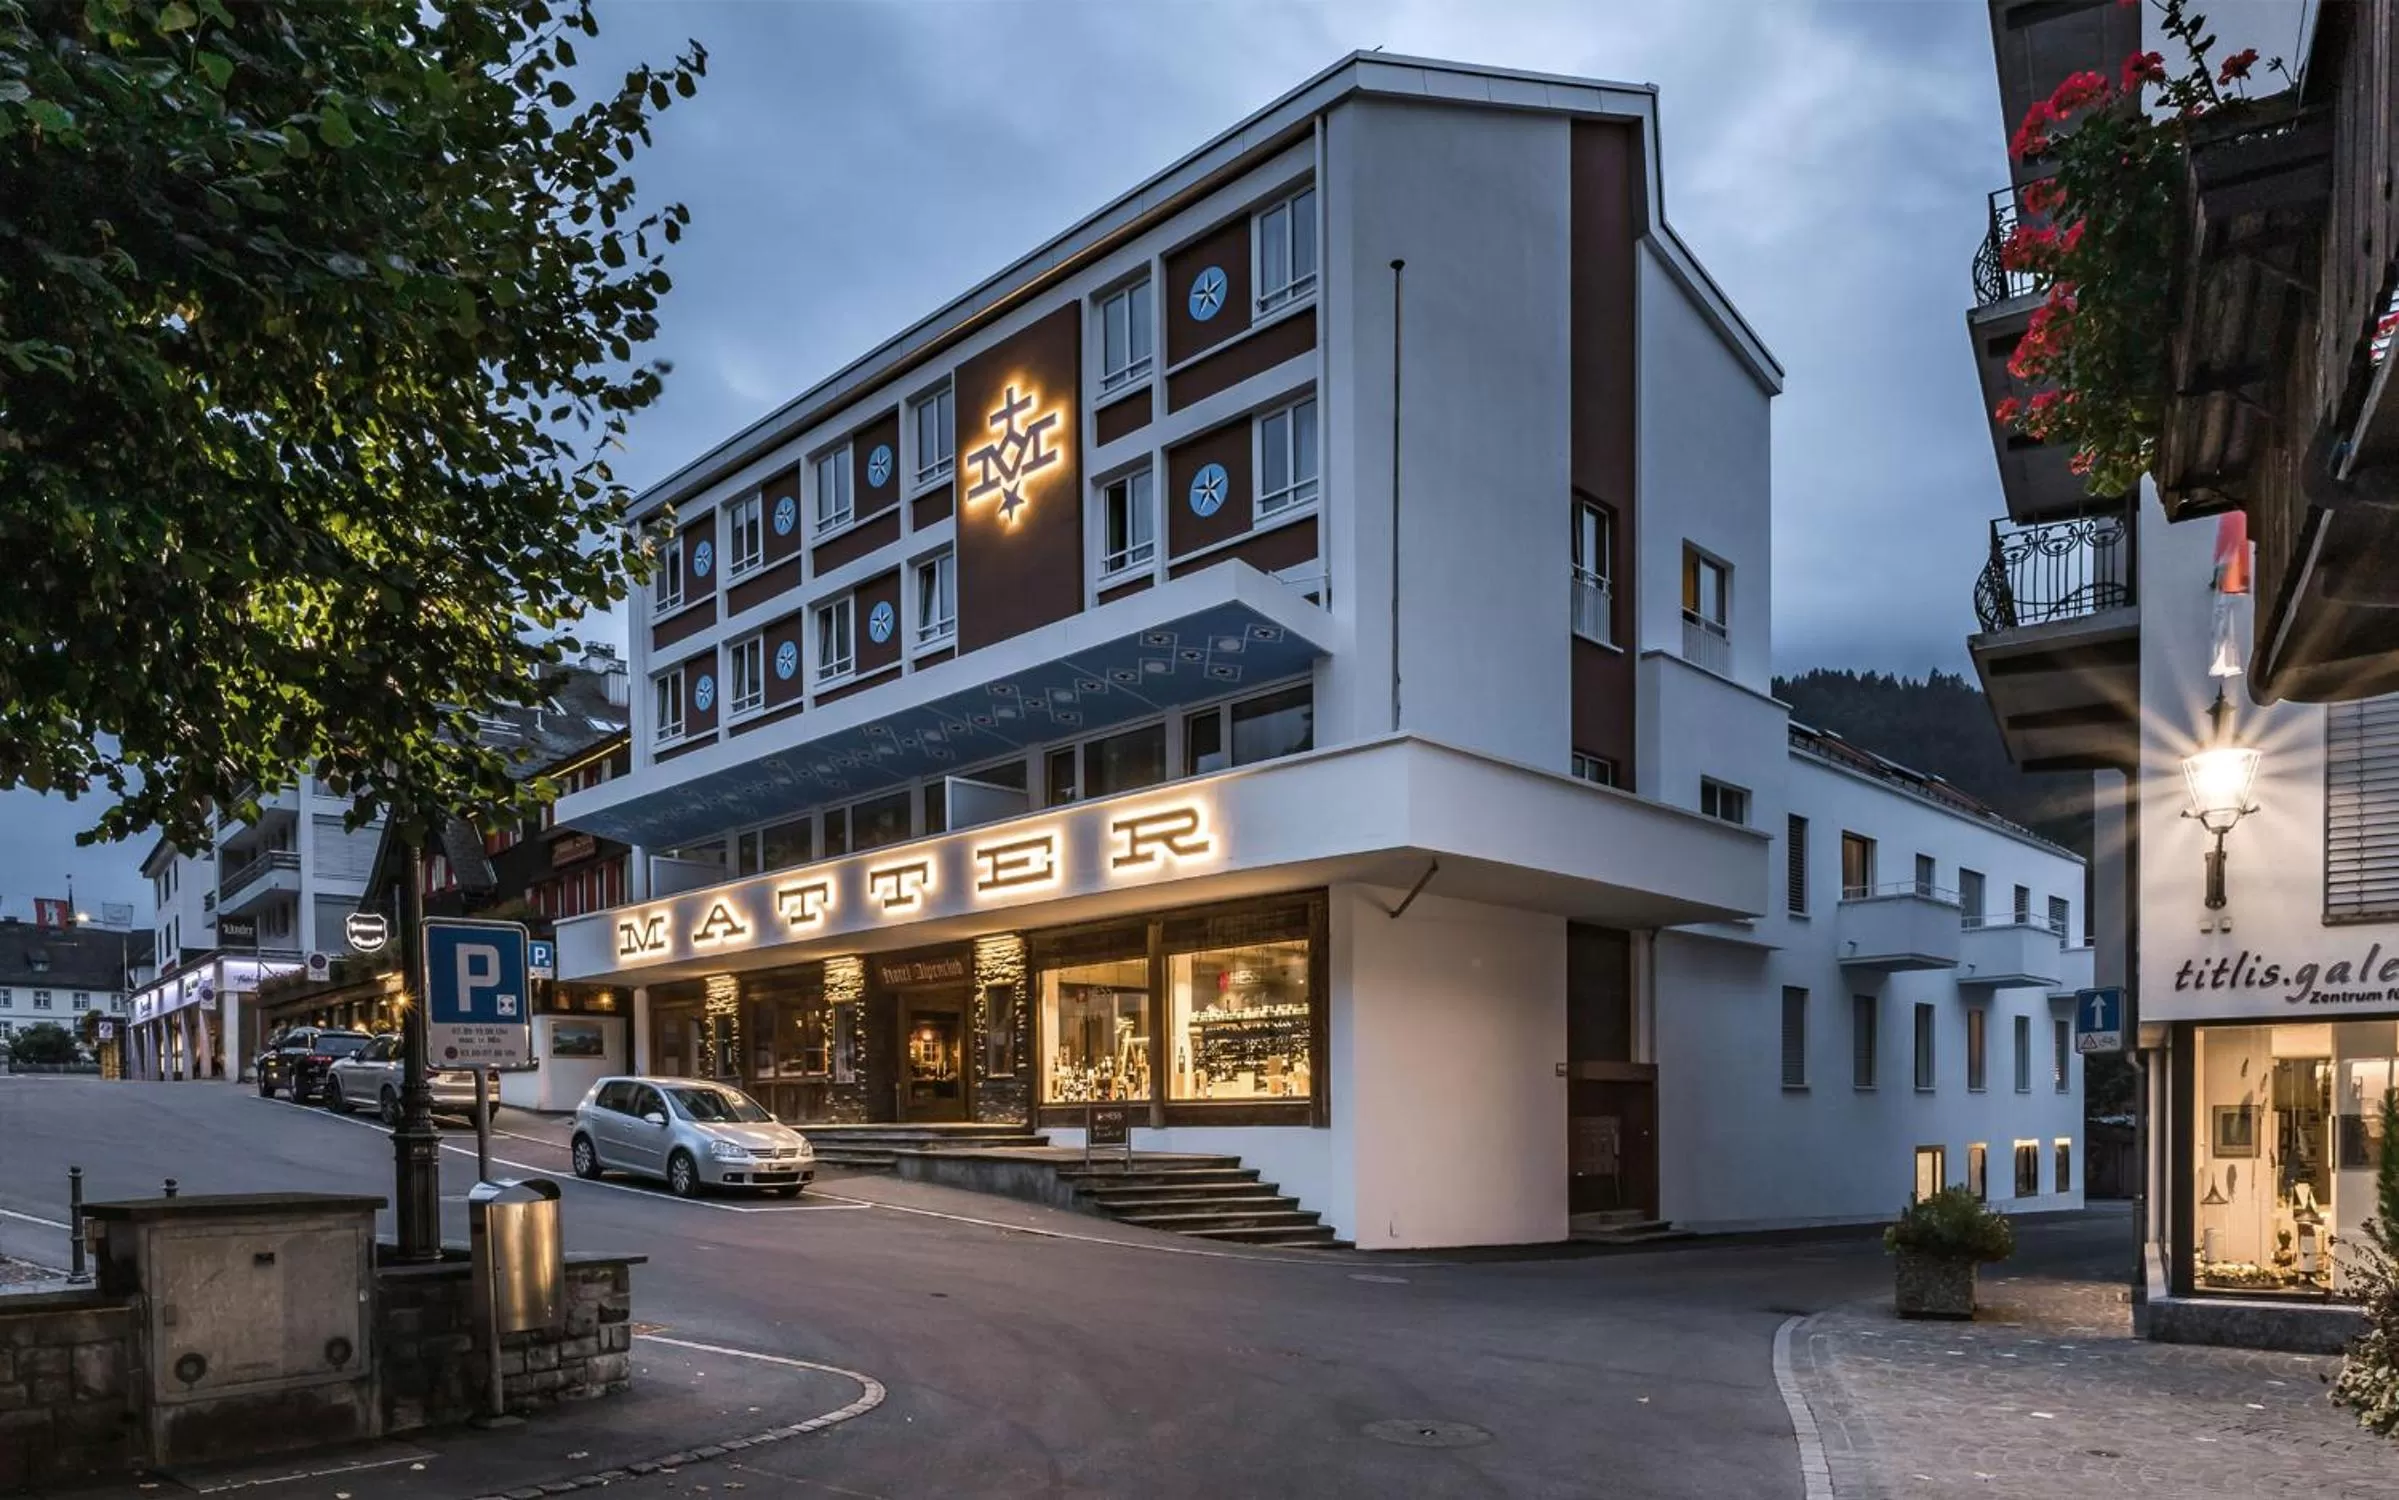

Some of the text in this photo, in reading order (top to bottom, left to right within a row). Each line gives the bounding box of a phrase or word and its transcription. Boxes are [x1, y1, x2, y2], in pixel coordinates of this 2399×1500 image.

[619, 806, 1210, 956] MATTER
[456, 943, 501, 1012] P
[535, 946, 546, 965] P
[2309, 991, 2382, 1005] Zentrum
